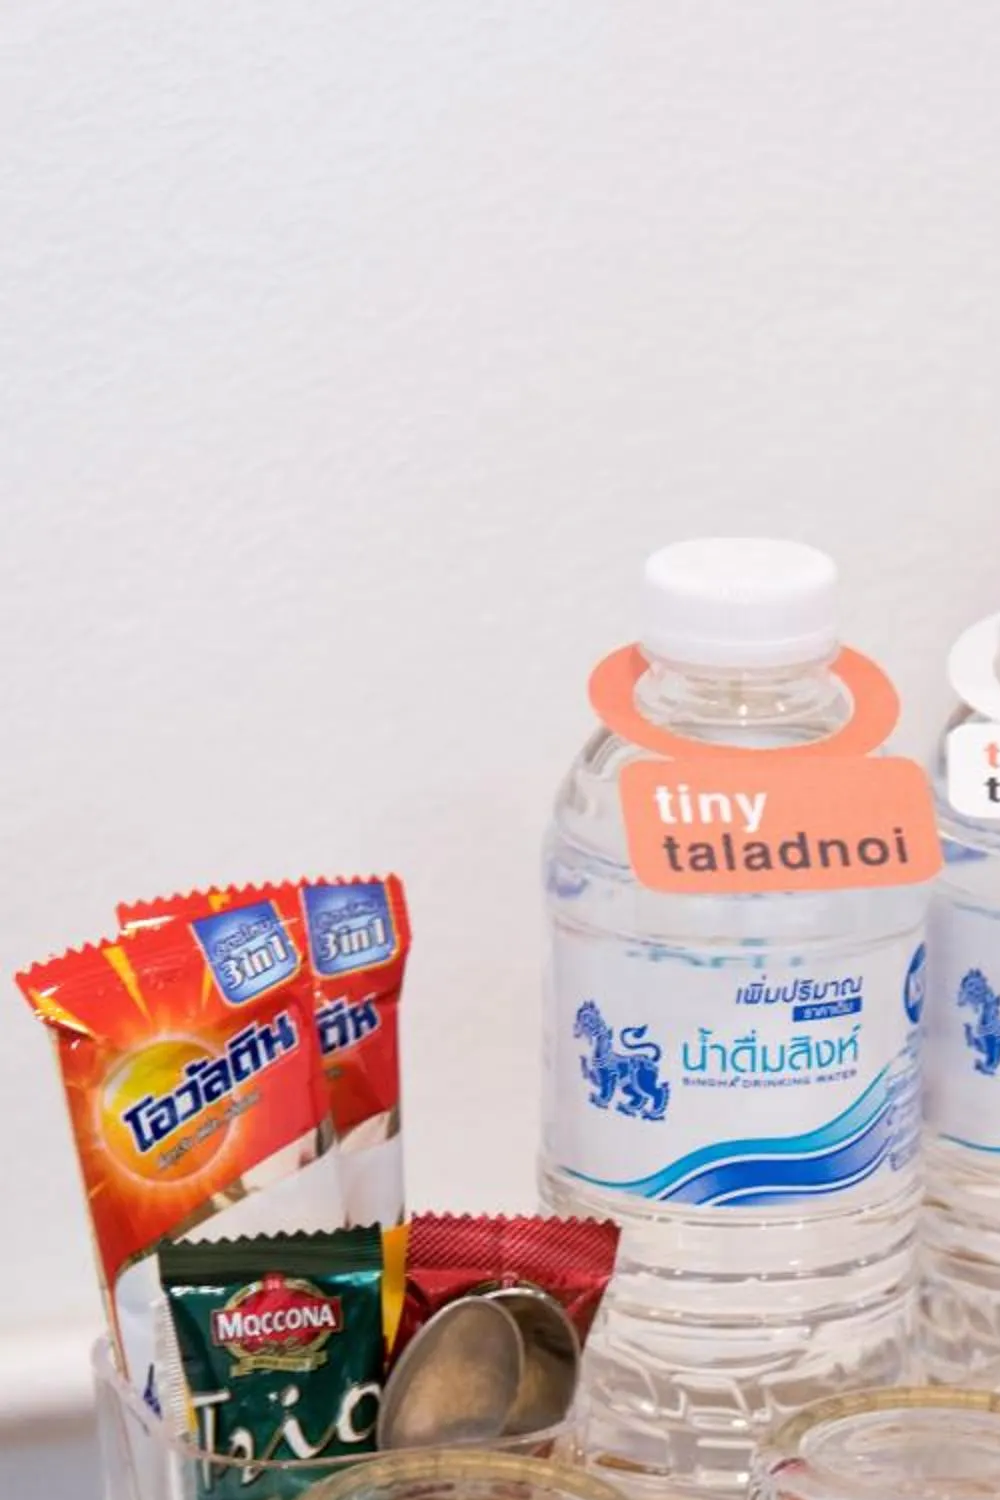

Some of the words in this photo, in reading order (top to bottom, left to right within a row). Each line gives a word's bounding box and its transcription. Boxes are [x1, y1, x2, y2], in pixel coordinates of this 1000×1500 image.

[655, 783, 767, 833] tiny
[663, 826, 909, 872] taladnoi
[221, 933, 289, 990] 3in1
[320, 916, 387, 962] 3in1
[735, 974, 863, 1005] เพิ่มปริมาณ
[682, 1023, 862, 1074] น้ำดื่มสิงห์
[123, 1012, 298, 1153] โอวัลติน
